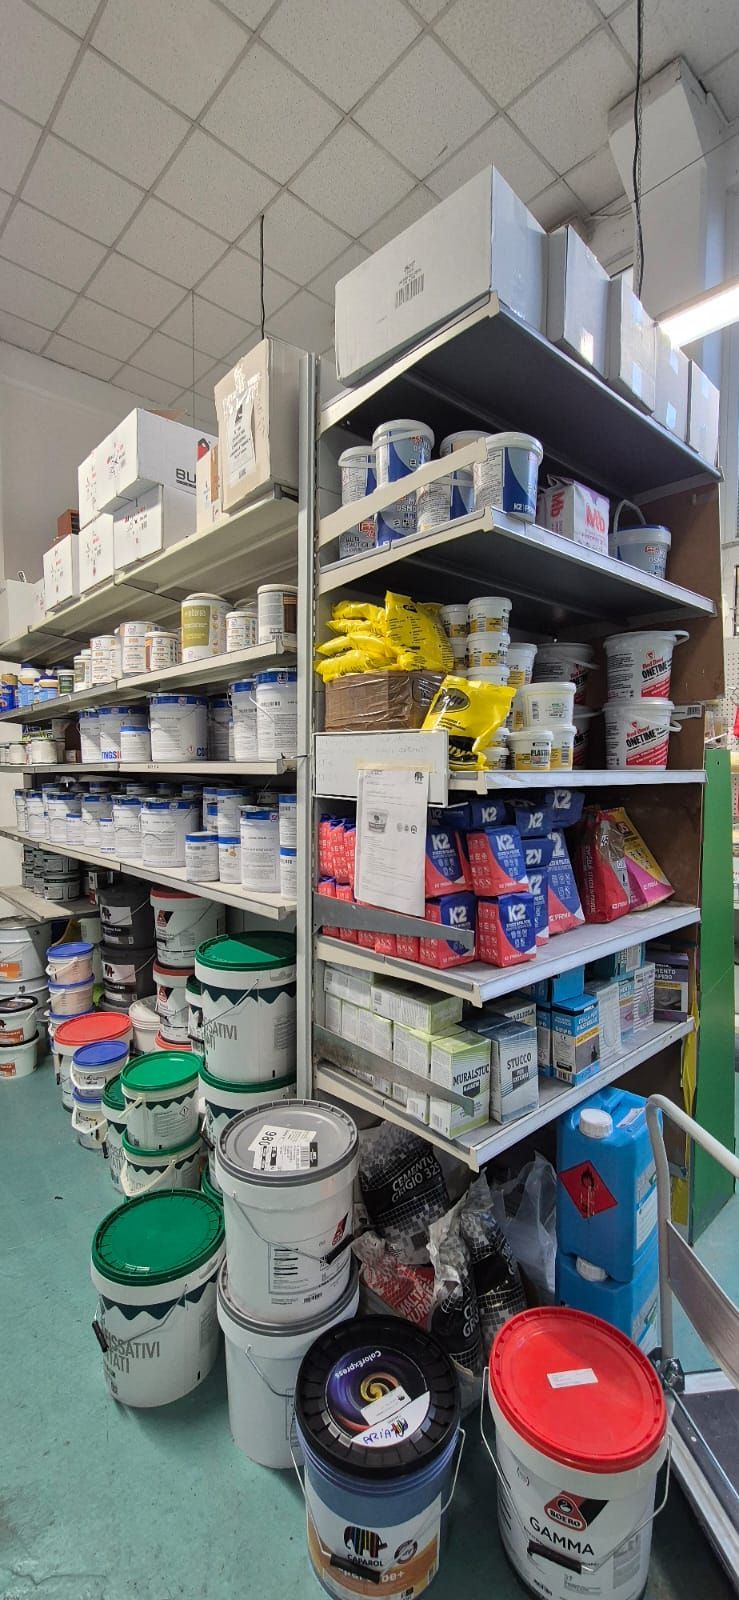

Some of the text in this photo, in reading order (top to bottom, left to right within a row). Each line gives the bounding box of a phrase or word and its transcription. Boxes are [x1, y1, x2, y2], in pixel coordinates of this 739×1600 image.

[641, 662, 668, 679] ONETIME
[625, 729, 657, 748] ONETIME
[481, 807, 497, 823] K2
[528, 812, 544, 829] K2
[431, 833, 451, 850] K2
[496, 834, 515, 851] K2
[449, 905, 468, 924] K2
[507, 903, 527, 922] K2
[507, 1052, 532, 1070] STUCCO
[335, 1350, 382, 1378] ColorExpress
[550, 1509, 581, 1528] BOERO
[529, 1516, 595, 1556] GAMMA
